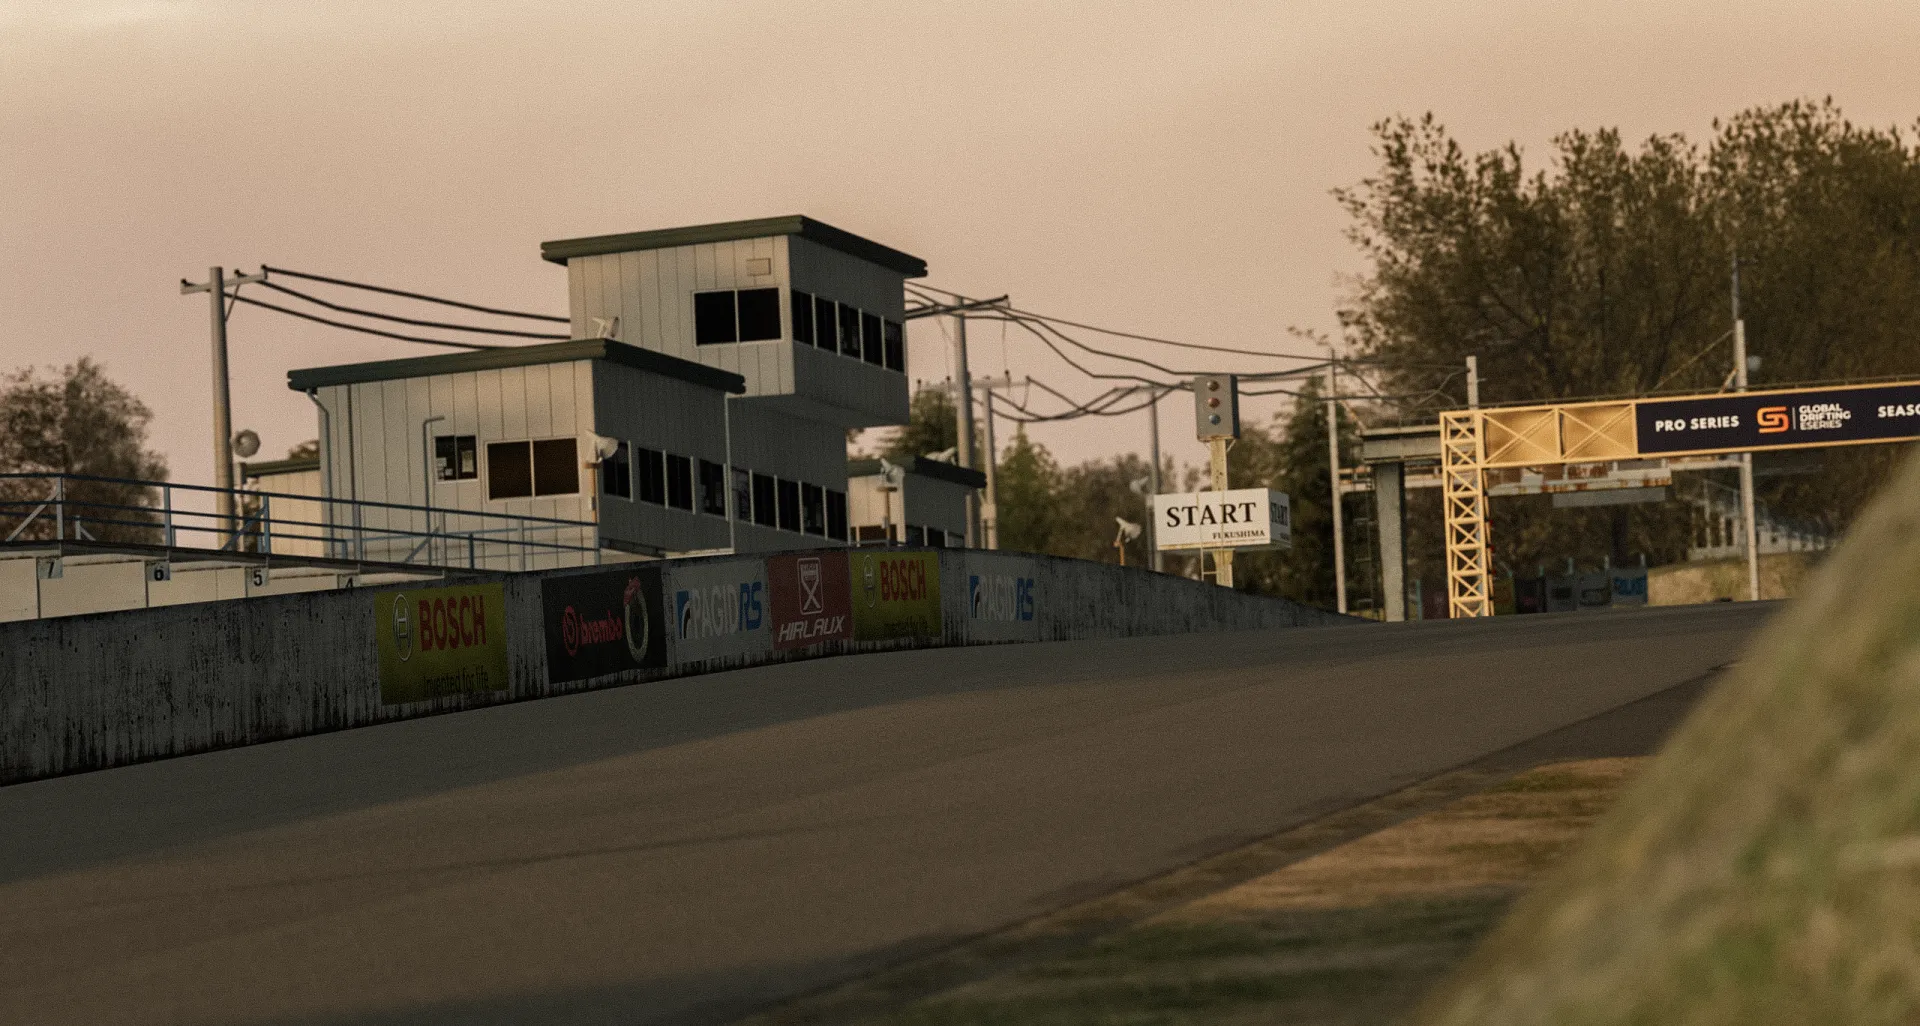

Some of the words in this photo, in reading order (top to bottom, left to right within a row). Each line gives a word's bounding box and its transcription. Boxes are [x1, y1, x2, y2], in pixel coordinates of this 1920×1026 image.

[1799, 403, 1841, 414] GLOBAL
[1799, 410, 1852, 421] DRIFTING
[1655, 419, 1686, 433] PRO
[1690, 415, 1740, 430] SERIES
[1800, 419, 1843, 431] ESERIES
[1166, 502, 1257, 528] START
[1212, 530, 1266, 540] FUKUSHIMA
[153, 566, 164, 581] 6
[252, 569, 263, 587] 5
[880, 560, 928, 602] BOSCH
[418, 594, 487, 651] BOSCH
[578, 608, 624, 646] brembo
[777, 615, 847, 643] HIRLAUX
